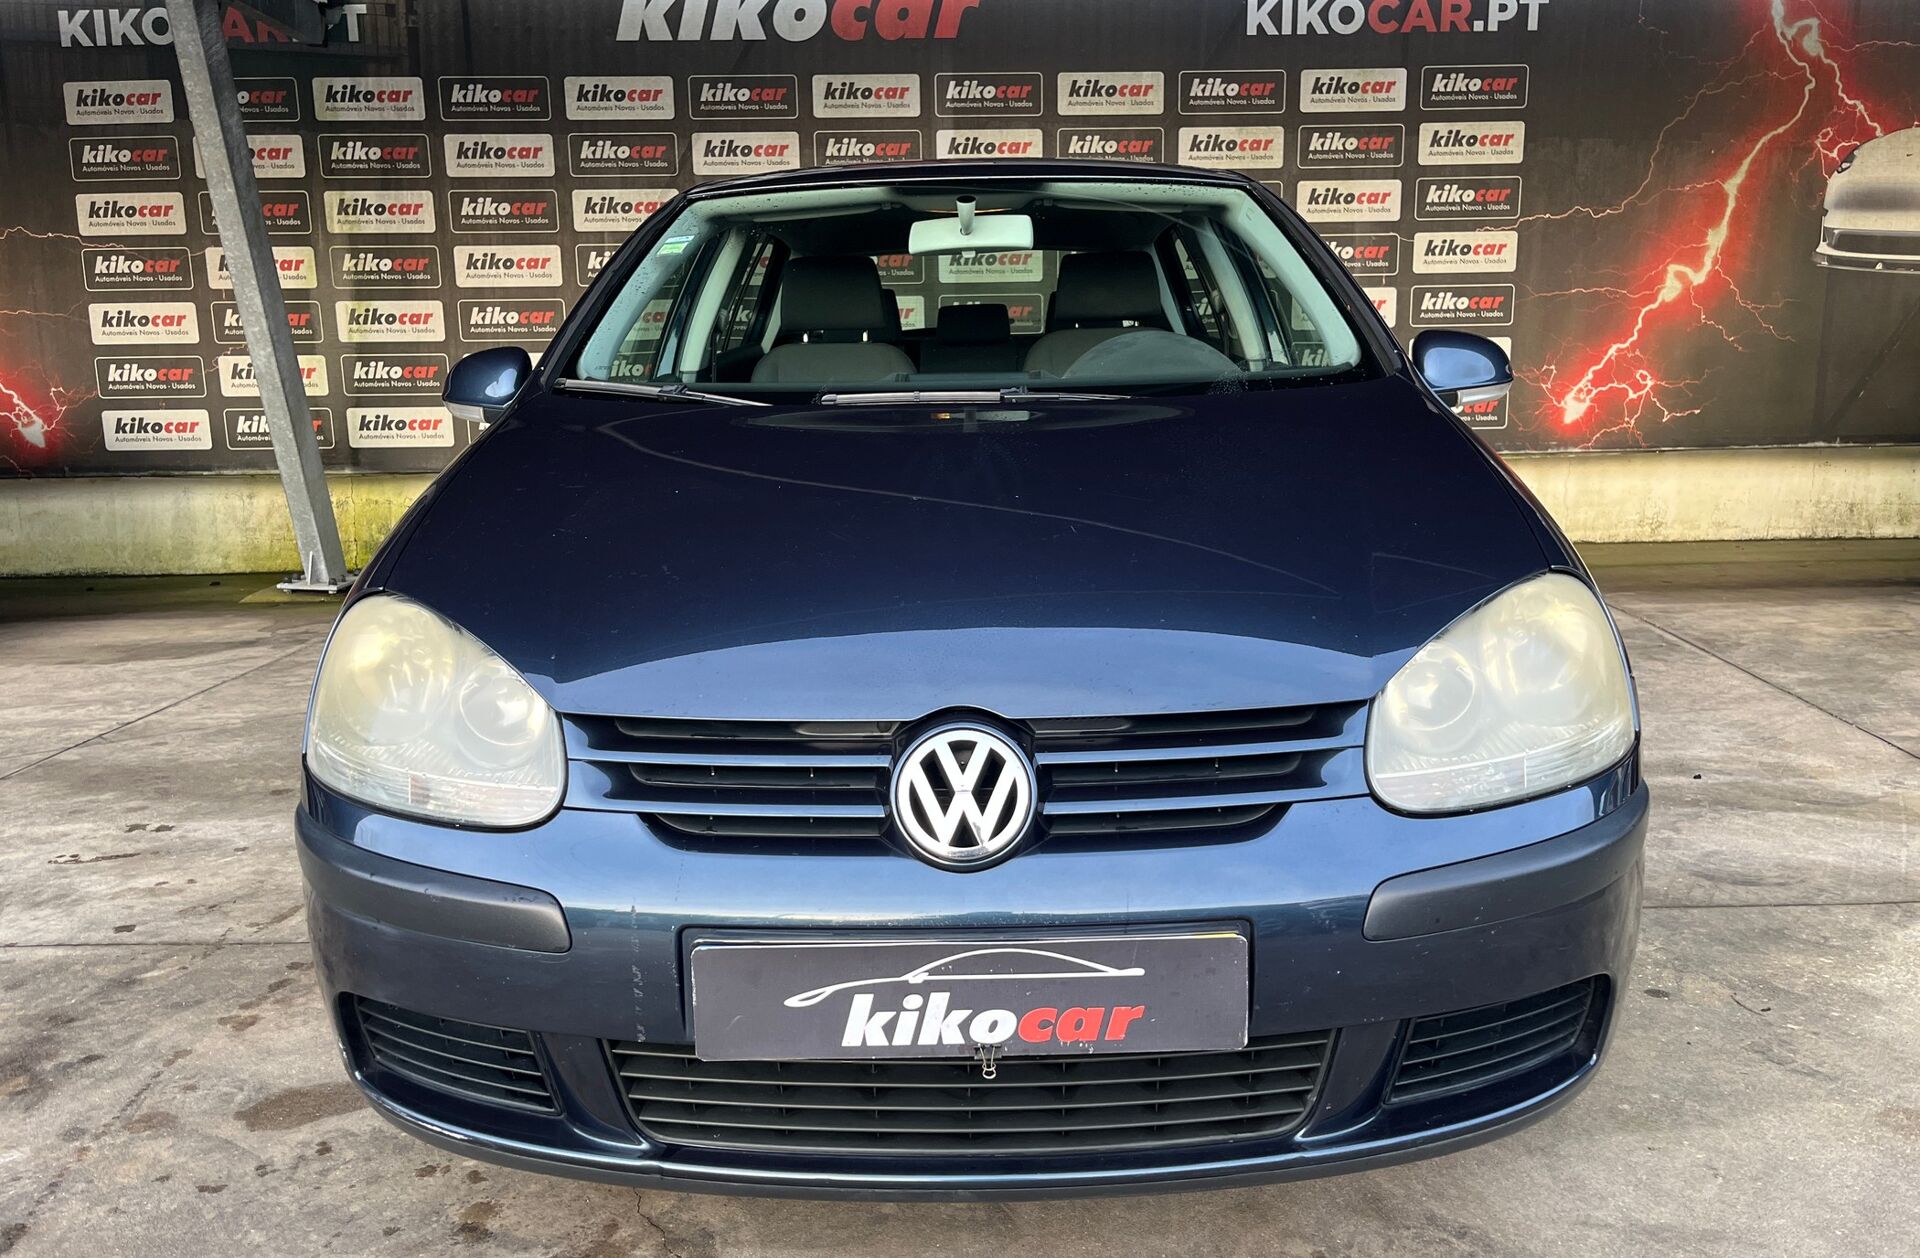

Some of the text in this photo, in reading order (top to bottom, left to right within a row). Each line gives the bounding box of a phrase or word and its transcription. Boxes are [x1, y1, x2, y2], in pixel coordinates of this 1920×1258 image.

[1246, 0, 1550, 35] KIKOCAR.PT
[823, 82, 910, 100] kikocar
[946, 80, 1032, 99] kikocar
[1068, 79, 1154, 98] kikocar
[1189, 78, 1276, 96] kikocar
[1310, 76, 1397, 95] kikocar
[1431, 73, 1518, 92] kikocar
[75, 88, 162, 107] kikocar
[325, 84, 413, 104] kikocar
[451, 84, 539, 104] kikocar
[576, 84, 663, 103] kikocar
[700, 83, 787, 102] kikocar
[1493, 92, 1517, 100] Usados
[139, 107, 163, 115] Usados
[516, 104, 540, 112] Usados
[886, 101, 910, 109] Usados
[825, 138, 911, 157] kikocar
[947, 137, 1032, 155] kikocar
[1068, 135, 1154, 154] kikocar
[1188, 134, 1274, 152] kikocar
[1308, 132, 1394, 151] kikocar
[1429, 129, 1515, 148] kikocar
[82, 144, 168, 163] kikocar
[331, 141, 418, 161] kikocar
[456, 141, 543, 160] kikocar
[580, 141, 666, 159] kikocar
[703, 139, 789, 158] kikocar
[1369, 151, 1393, 159] Usados
[146, 163, 169, 171] Usados
[396, 161, 420, 169] Usados
[1307, 188, 1392, 205] kikocar
[1426, 184, 1511, 203] kikocar
[88, 200, 174, 219] kikocar
[336, 198, 424, 217] kikocar
[461, 197, 547, 216] kikocar
[401, 217, 425, 225] Usados
[1423, 239, 1508, 256] kikocar
[94, 255, 180, 274] kikocar
[342, 253, 429, 272] kikocar
[465, 252, 551, 270] kikocar
[1420, 292, 1504, 310] kikocar
[101, 310, 187, 328] kikocar
[348, 308, 433, 326] kikocar
[470, 307, 554, 324] kikocar
[108, 364, 193, 381] kikocar
[353, 361, 438, 379] kikocar
[114, 417, 199, 434] kikocar
[358, 414, 443, 431] kikocar
[841, 992, 1145, 1046] kikocar
